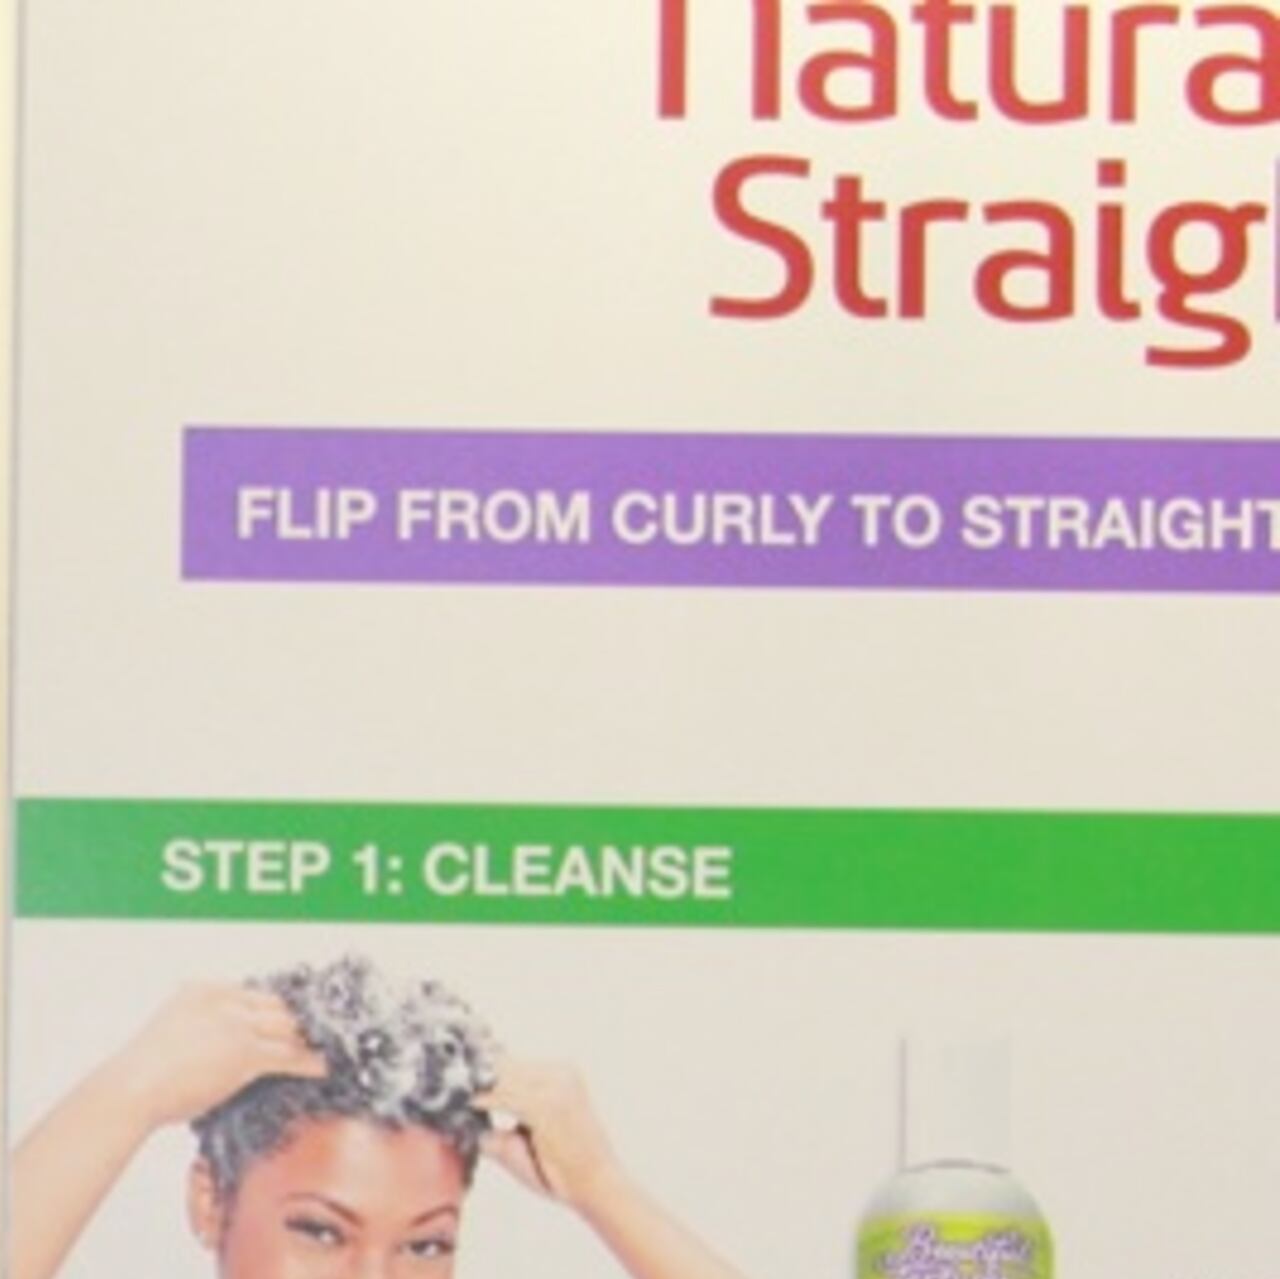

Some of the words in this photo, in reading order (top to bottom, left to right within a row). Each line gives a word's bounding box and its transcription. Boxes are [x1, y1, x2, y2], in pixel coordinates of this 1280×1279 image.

[708, 153, 1280, 369] Straig
[236, 486, 378, 541] FLIP
[397, 489, 590, 543] FROM
[612, 492, 834, 546] CURLY
[851, 495, 942, 548] TO
[961, 497, 1280, 552] STRAIGHT
[160, 839, 331, 893] STEP
[353, 844, 404, 895] 1:
[423, 843, 733, 898] CLEANSE
